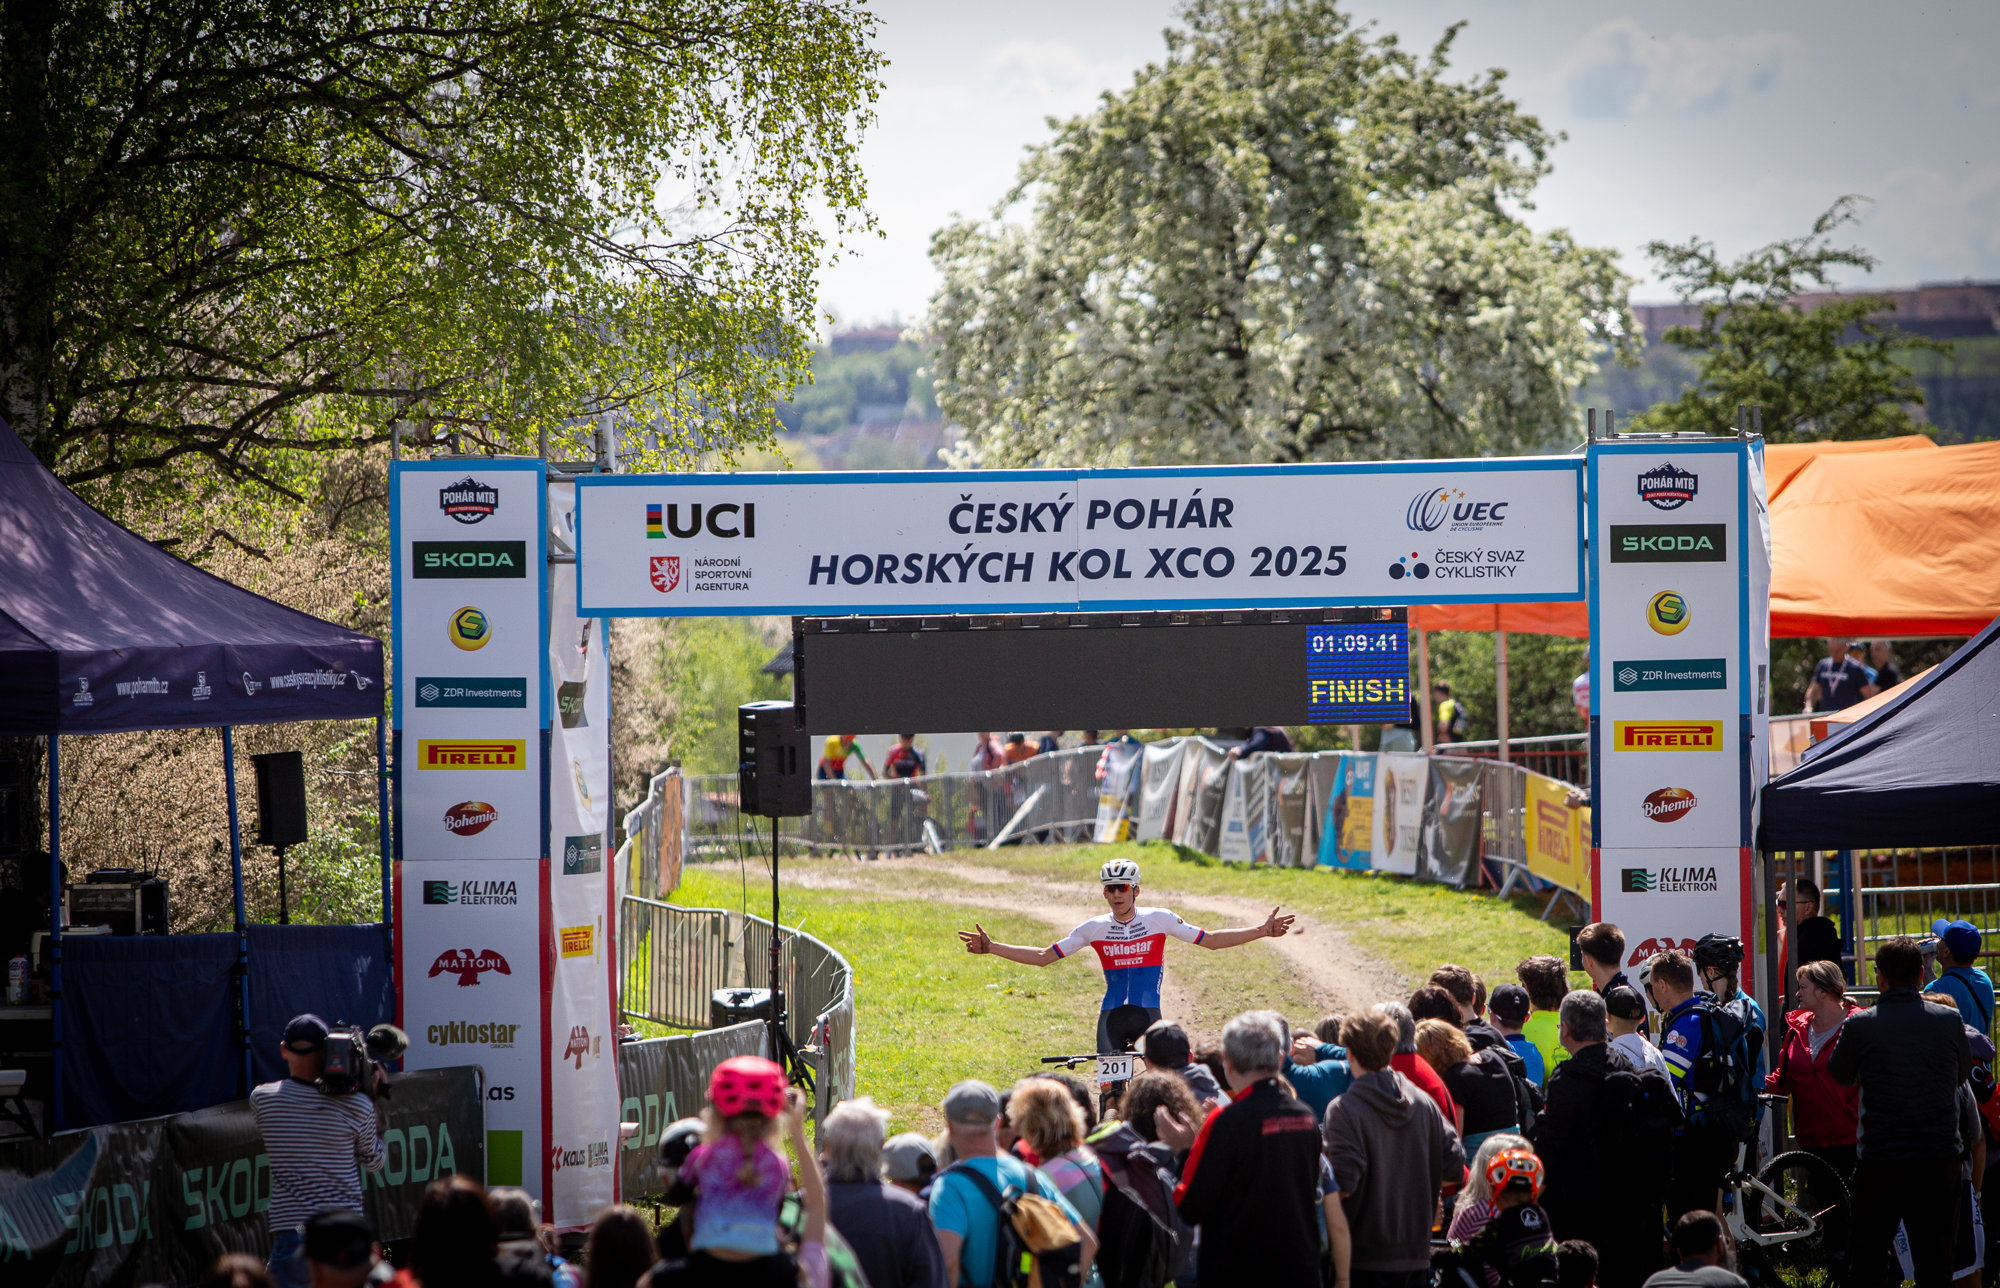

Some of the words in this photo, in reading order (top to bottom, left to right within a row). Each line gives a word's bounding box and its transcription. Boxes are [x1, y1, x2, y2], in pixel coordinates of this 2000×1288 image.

[1641, 475, 1673, 490] POHÁR
[1675, 477, 1695, 490] MTB
[443, 489, 474, 504] POHÁR
[476, 491, 495, 504] MTB
[948, 493, 1075, 534] ČESKÝ
[1086, 488, 1235, 530] POHÁR
[1453, 502, 1509, 521] UEC
[667, 503, 755, 538] UCI
[694, 556, 741, 567] NÁRODNÍ
[1435, 548, 1483, 563] ČESKÝ
[1487, 550, 1525, 562] SVAZ
[808, 543, 1035, 585] HORSKÝCH
[1048, 548, 1133, 583] KOL
[1144, 547, 1235, 580] XCO
[1249, 545, 1347, 577] 2025
[1435, 565, 1517, 578] CYKLISTIKY
[694, 567, 752, 579] SPORTOVNÍ
[694, 582, 749, 591] AGENTURA
[1312, 634, 1397, 652] 01:09:41
[1642, 671, 1663, 680] ZDR
[1664, 669, 1722, 680] Investments
[444, 687, 464, 697] ZDR
[465, 687, 522, 698] Investments
[1312, 679, 1404, 703] FINISH
[1624, 726, 1714, 746] PIRELLI
[428, 745, 517, 764] PIRELLI
[1641, 797, 1697, 818] Bohemia
[443, 810, 498, 831] Bohemia
[1659, 867, 1717, 882] KLIMA
[461, 881, 517, 895] KLIMA
[1659, 882, 1717, 892] ELEKTRON
[461, 896, 517, 905] ELEKTRON
[562, 931, 590, 953] PIRELLI
[1103, 940, 1152, 956] cyklostar
[438, 958, 500, 968] MATTONI
[428, 1021, 517, 1046] cyklostar
[1102, 1062, 1127, 1074] 201
